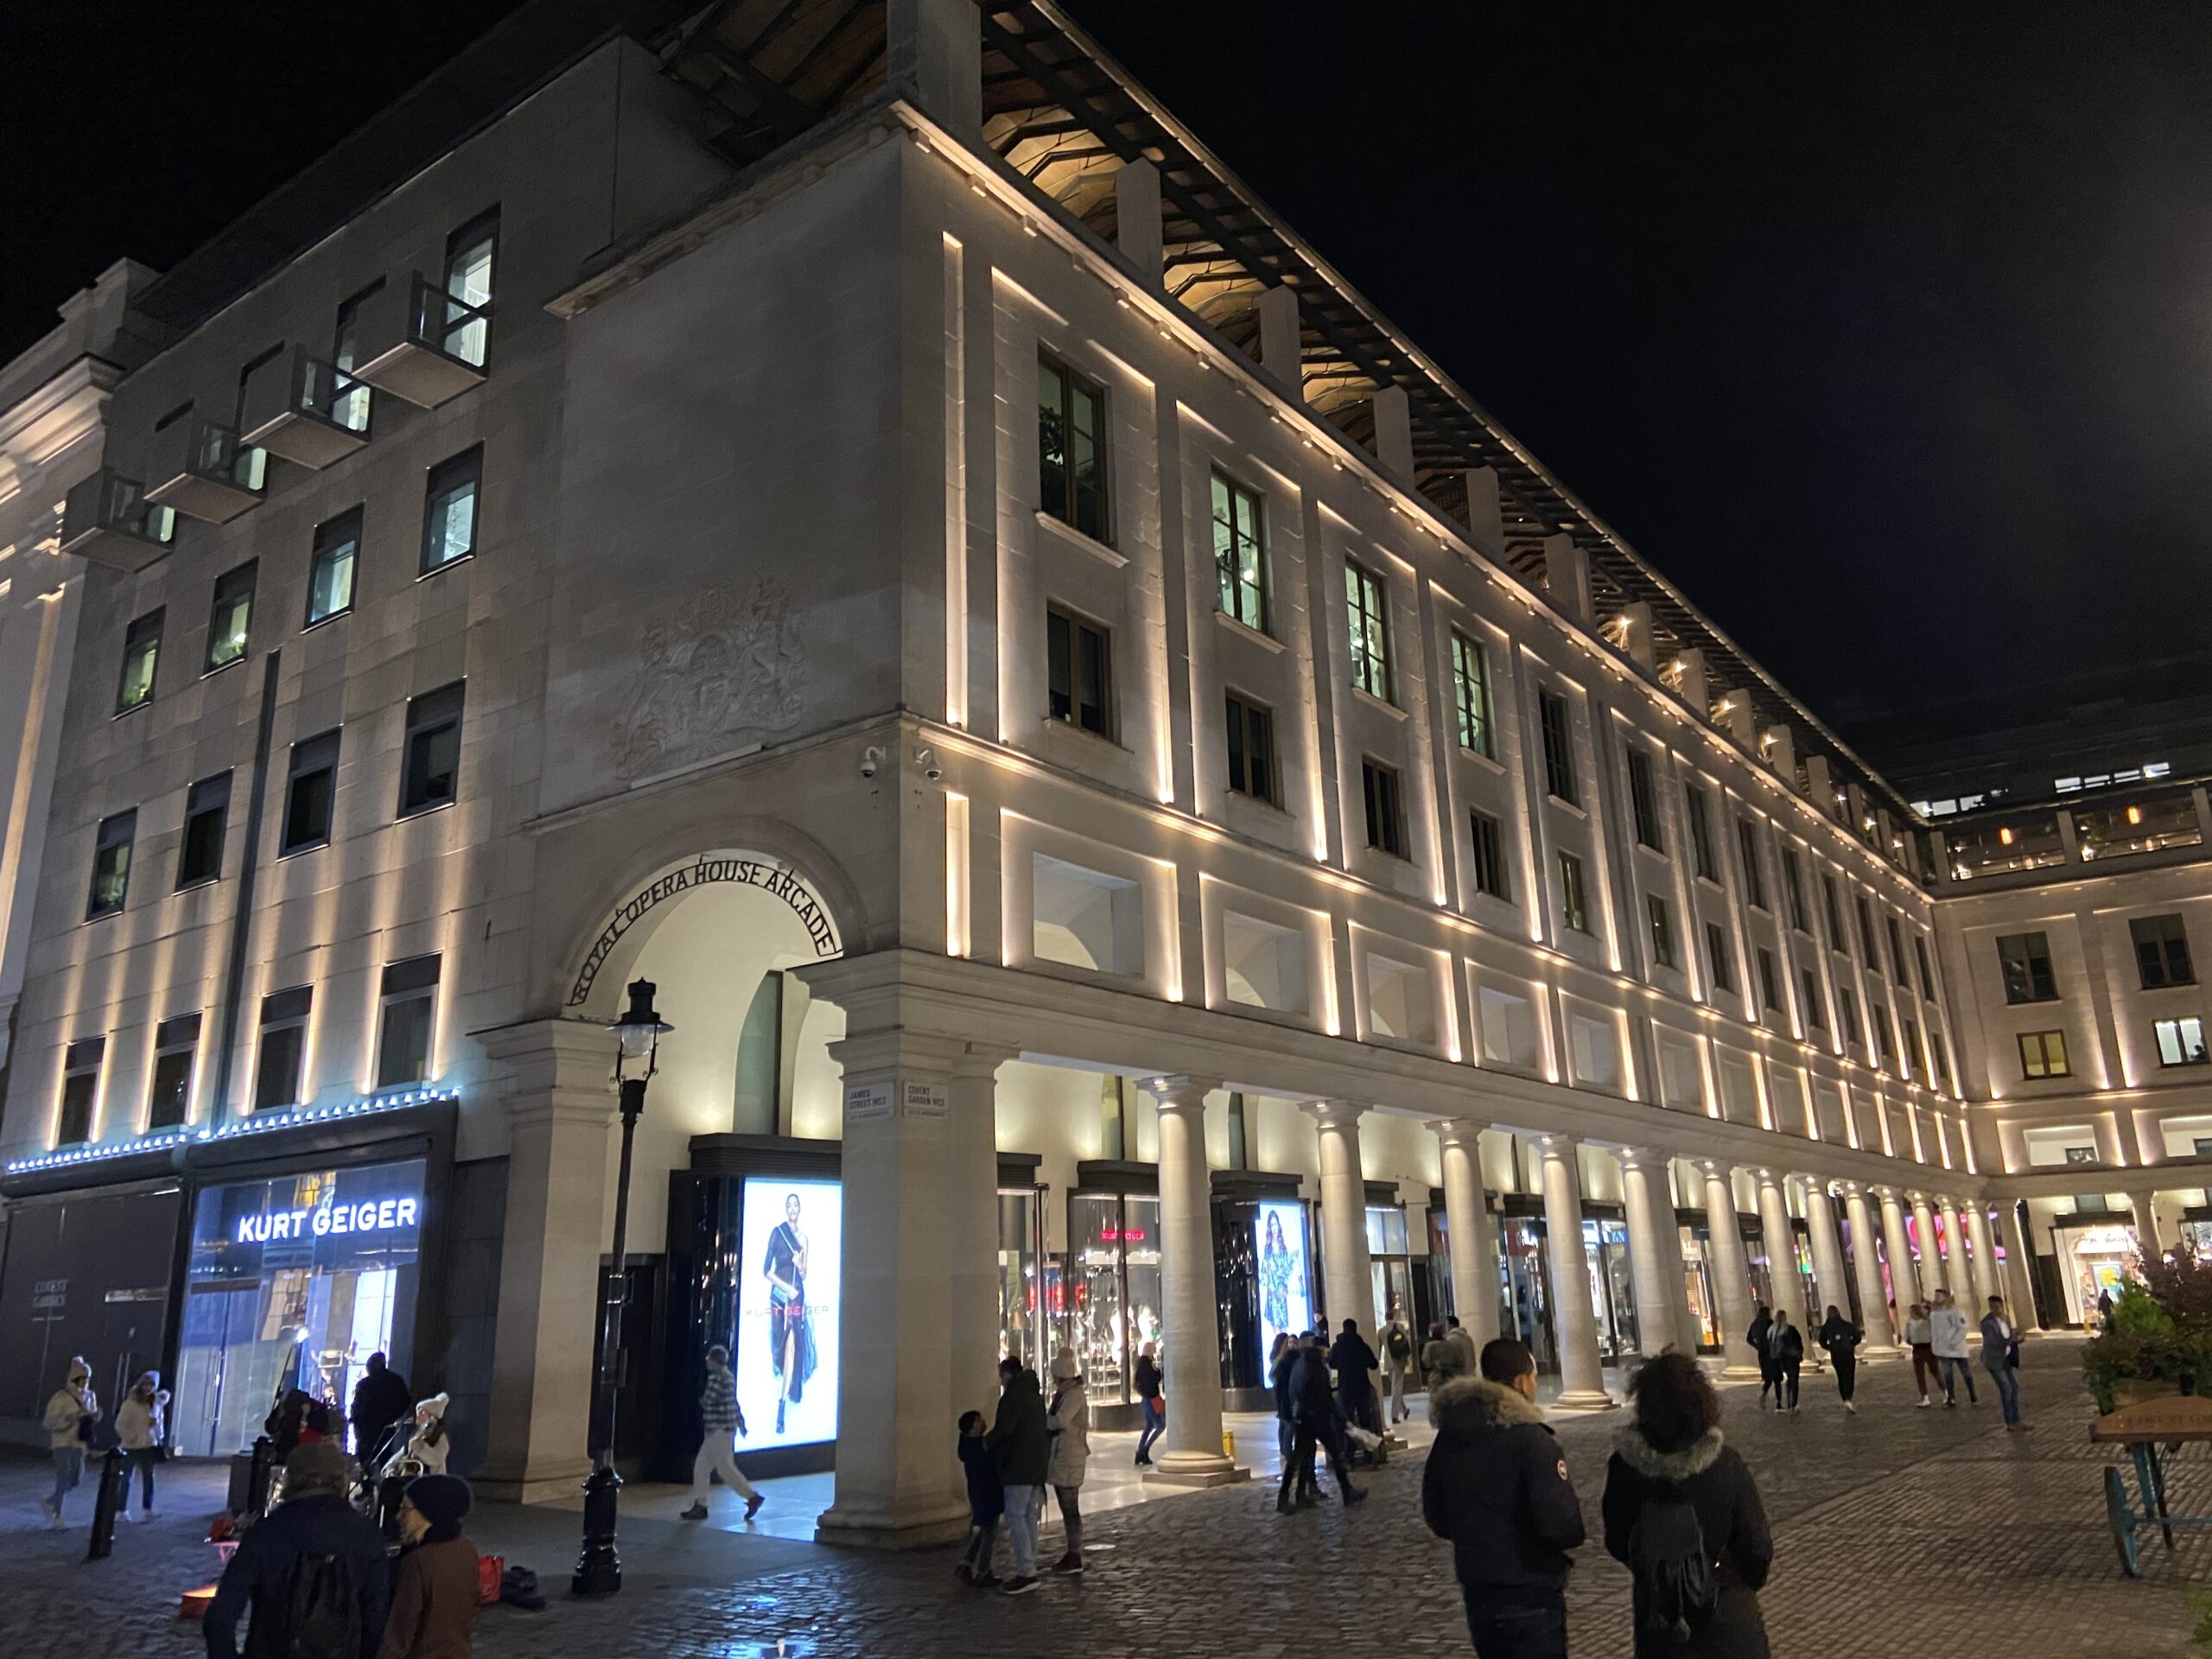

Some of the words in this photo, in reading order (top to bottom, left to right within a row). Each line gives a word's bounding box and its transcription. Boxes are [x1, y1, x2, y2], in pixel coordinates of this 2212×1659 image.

[573, 922, 624, 1001] ROYAL
[626, 869, 689, 921] OPERA
[695, 861, 761, 885] HOUSE
[764, 871, 833, 955] ARCADE
[850, 1089, 871, 1101] JAMES
[907, 1085, 931, 1096] COVENT
[849, 1098, 871, 1109] STREET
[907, 1095, 931, 1106] GARDEN
[238, 1211, 308, 1243] KURT
[312, 1198, 416, 1236] GEIGER
